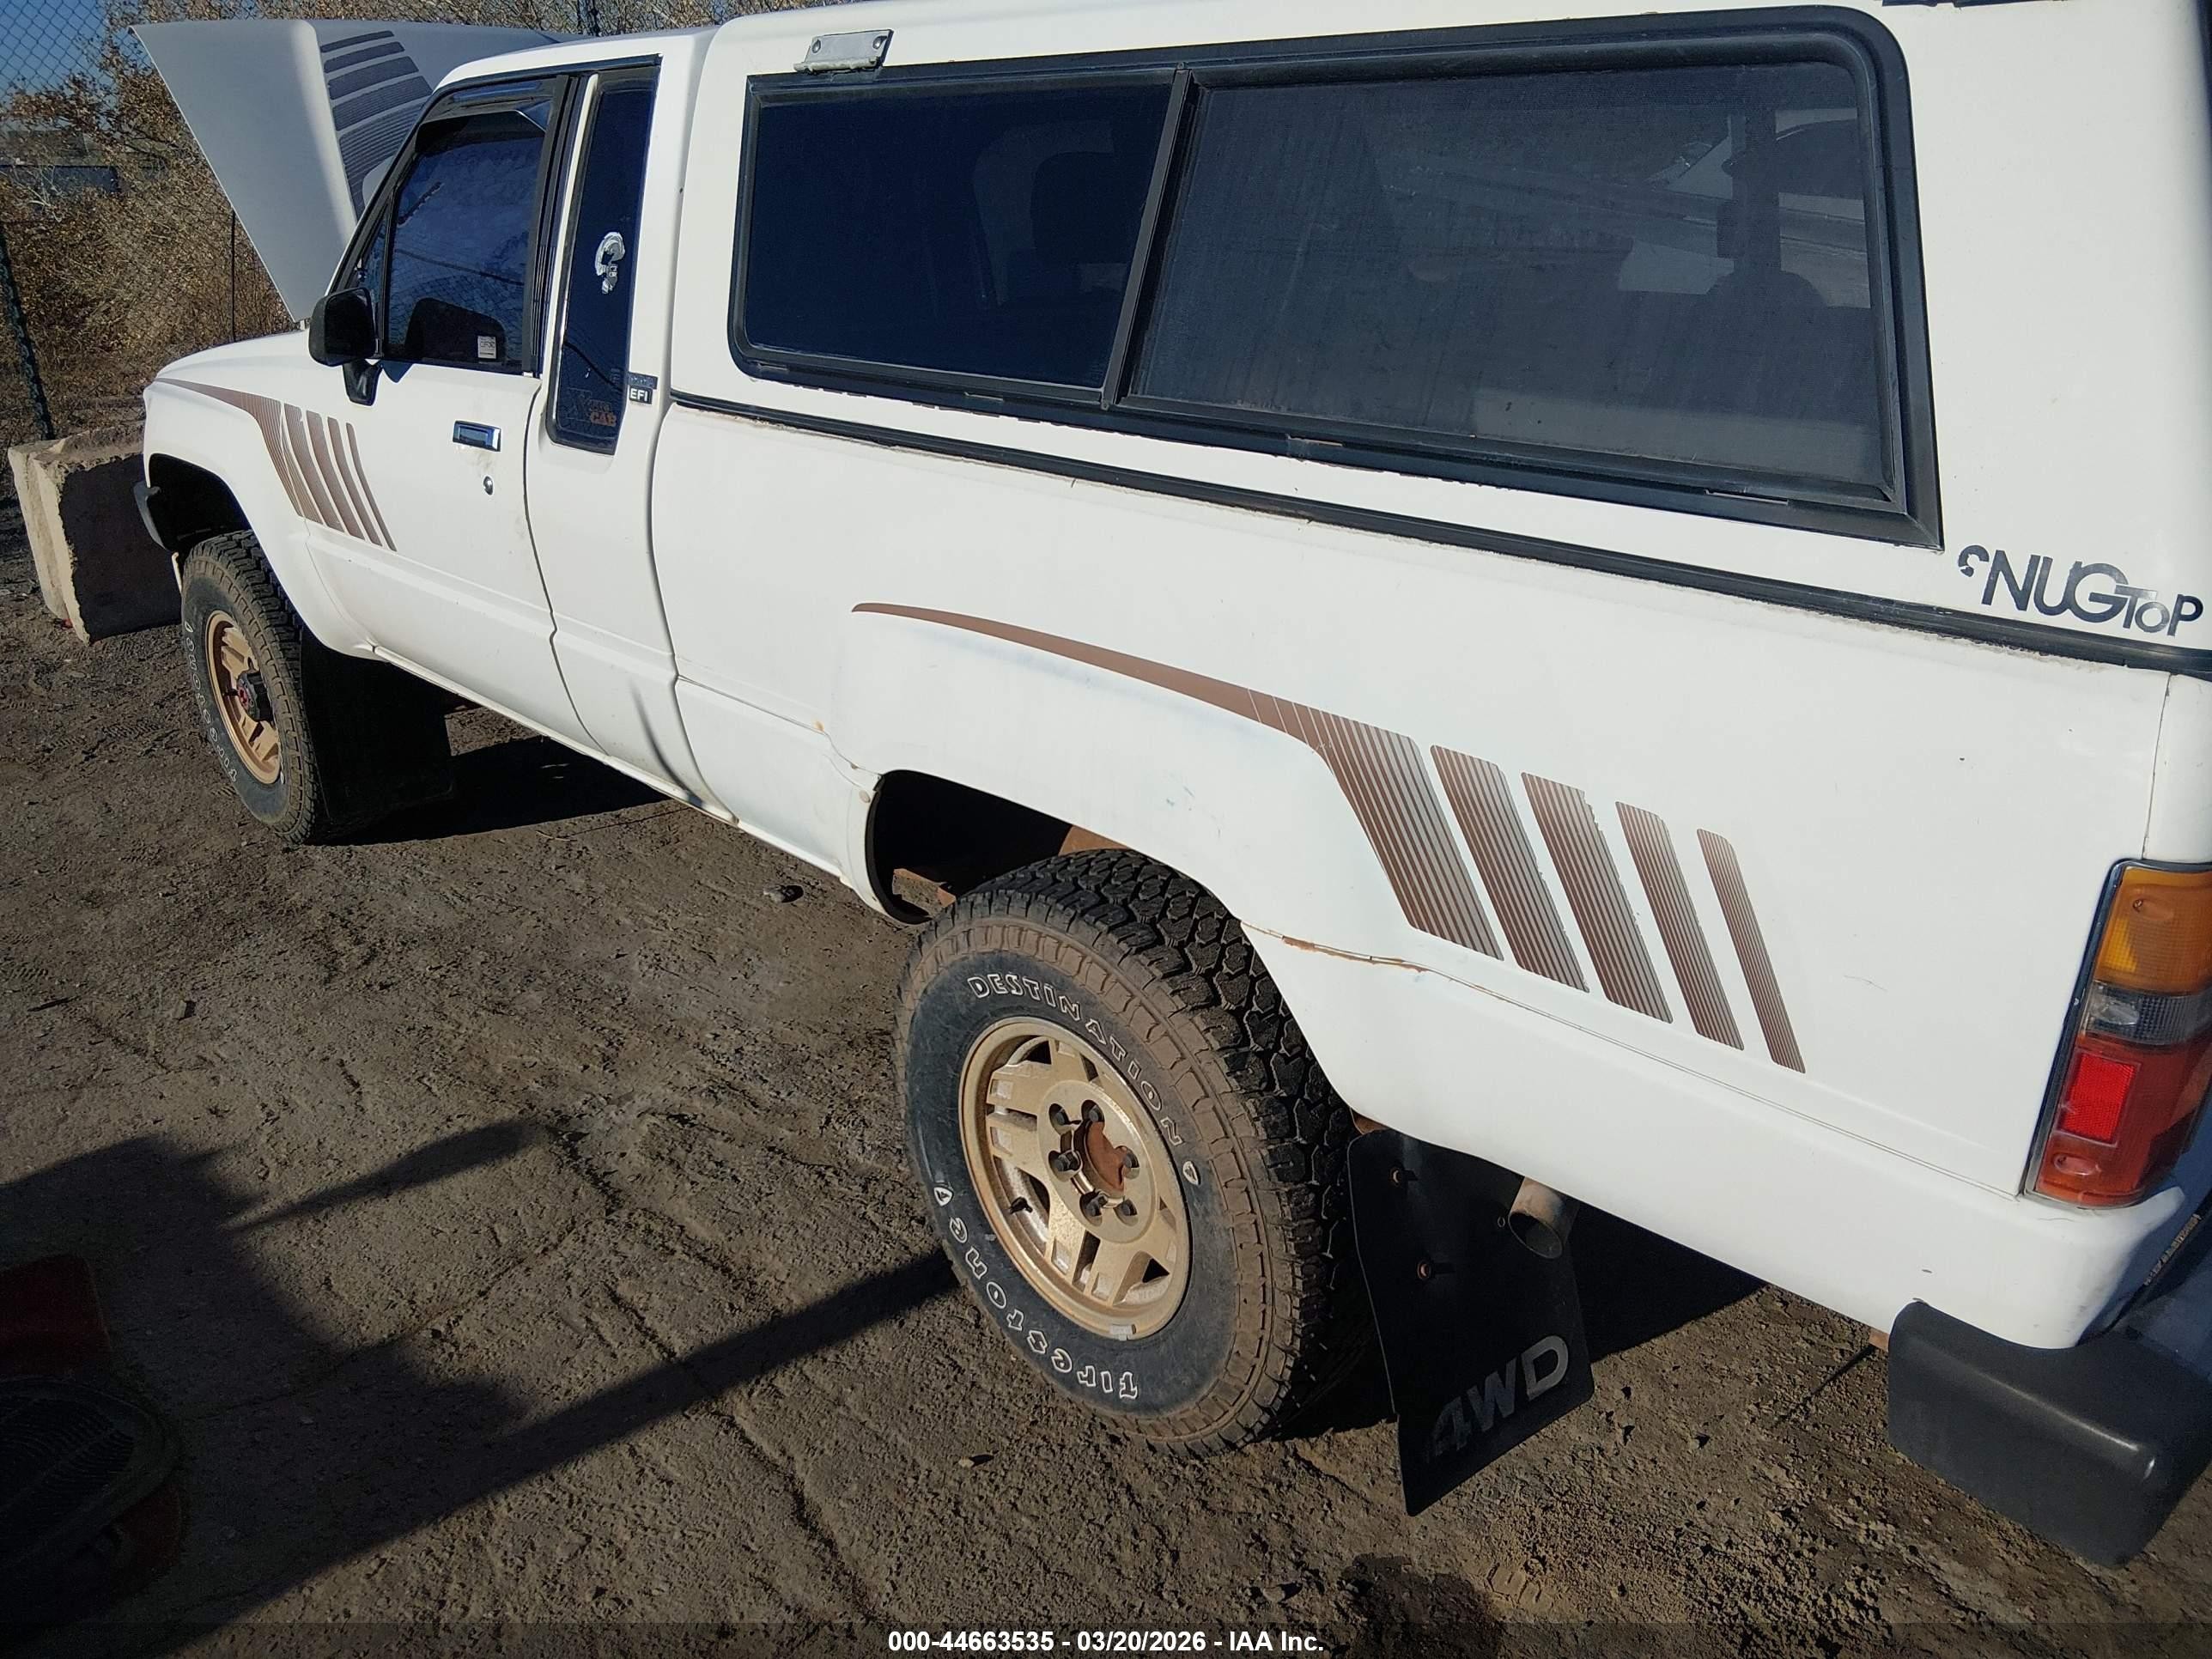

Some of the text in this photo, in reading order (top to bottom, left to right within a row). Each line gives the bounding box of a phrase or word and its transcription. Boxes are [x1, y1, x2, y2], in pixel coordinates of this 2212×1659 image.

[629, 387, 648, 402] EFI
[967, 973, 1184, 1146] DESTINATION
[1430, 1334, 1569, 1460] 4WD
